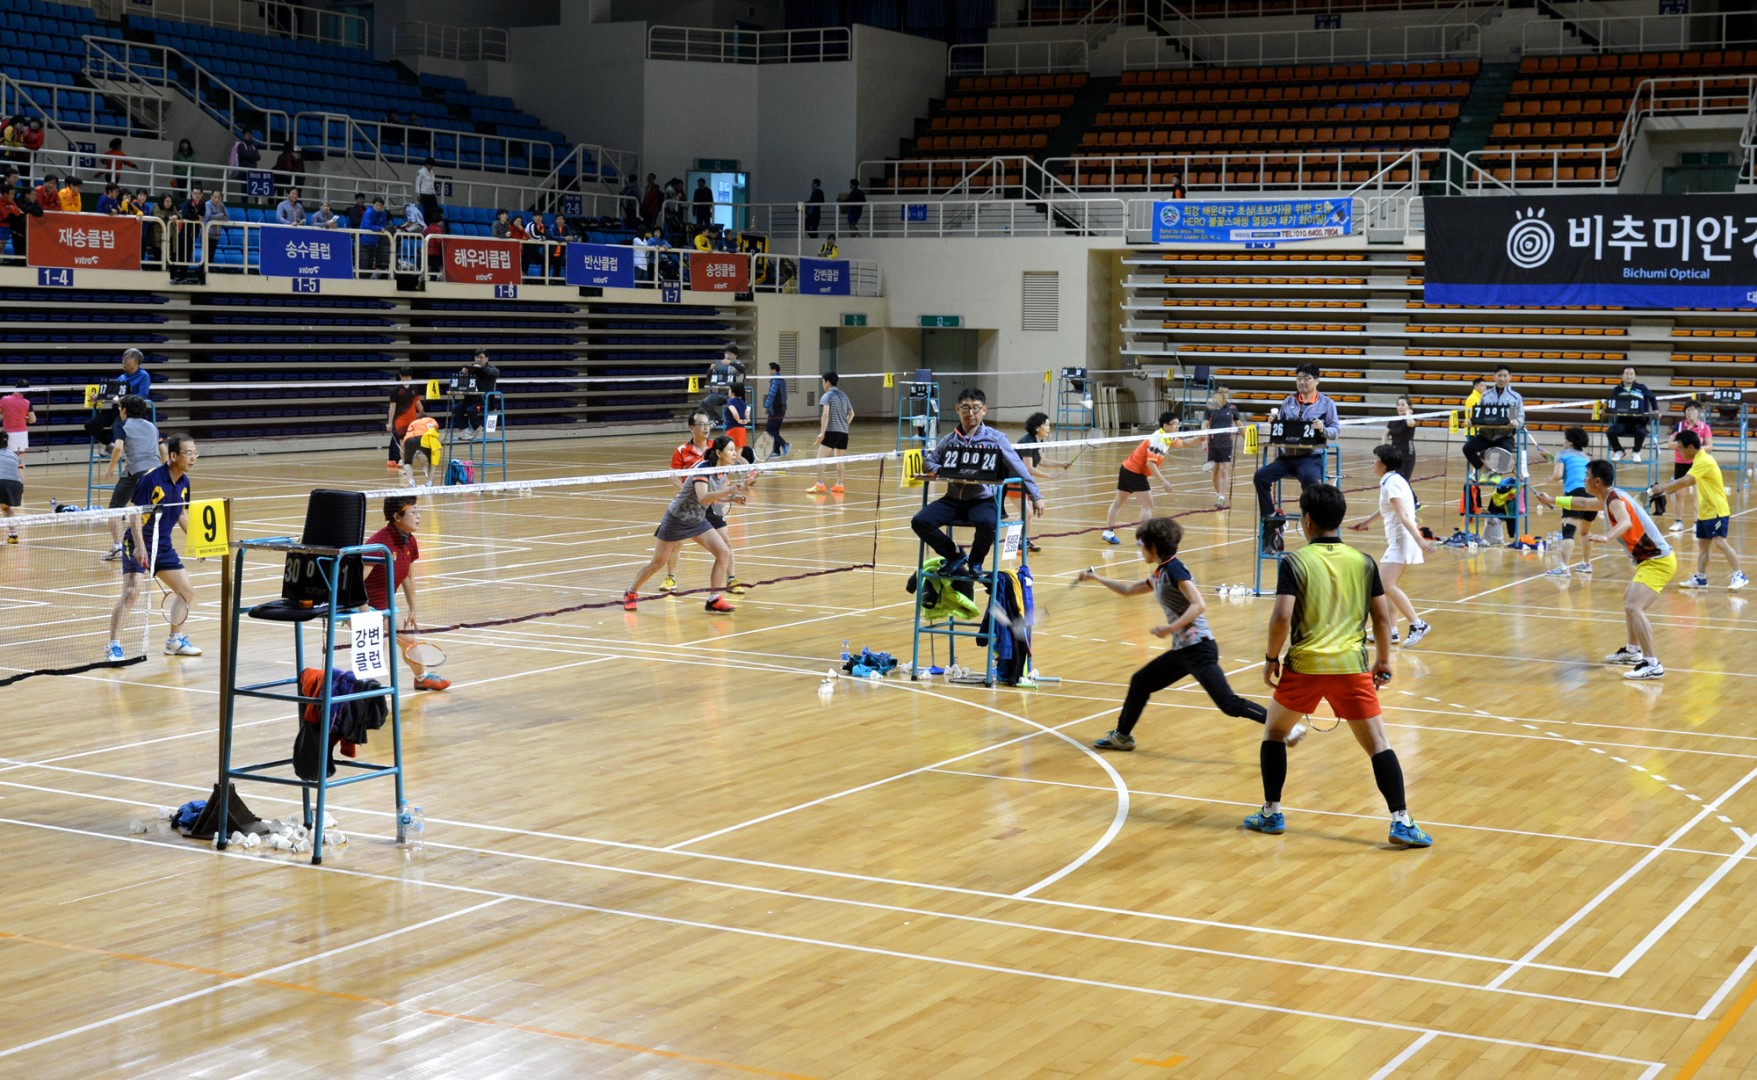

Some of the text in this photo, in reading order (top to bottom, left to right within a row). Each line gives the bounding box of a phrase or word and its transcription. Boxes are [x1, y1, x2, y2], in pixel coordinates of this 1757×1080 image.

[251, 181, 270, 195] 2-5
[566, 203, 580, 214] 2-6
[1183, 217, 1206, 226] HERO
[59, 227, 115, 249] 재송클럽
[285, 240, 331, 260] 송수클럽
[454, 248, 512, 269] 해우리클럽
[44, 269, 69, 286] 1-4
[706, 263, 736, 278] 송정클럽
[1623, 268, 1710, 280] Bichumi Optical
[297, 278, 317, 292] 1-5
[499, 284, 515, 298] 1-6
[665, 290, 679, 303] 1-7
[431, 381, 437, 394] 4
[692, 377, 697, 389] 5
[1475, 407, 1481, 418] 7
[1485, 407, 1490, 415] 0
[1492, 407, 1497, 415] 0
[1249, 428, 1256, 447] 11
[1272, 423, 1315, 438] 26 24
[908, 453, 920, 478] 10
[943, 451, 997, 470] 22 0 0 24
[202, 505, 217, 542] 9
[285, 558, 300, 583] 30
[306, 561, 315, 578] 0
[355, 626, 381, 648] 강변
[355, 650, 382, 672] 클럽
